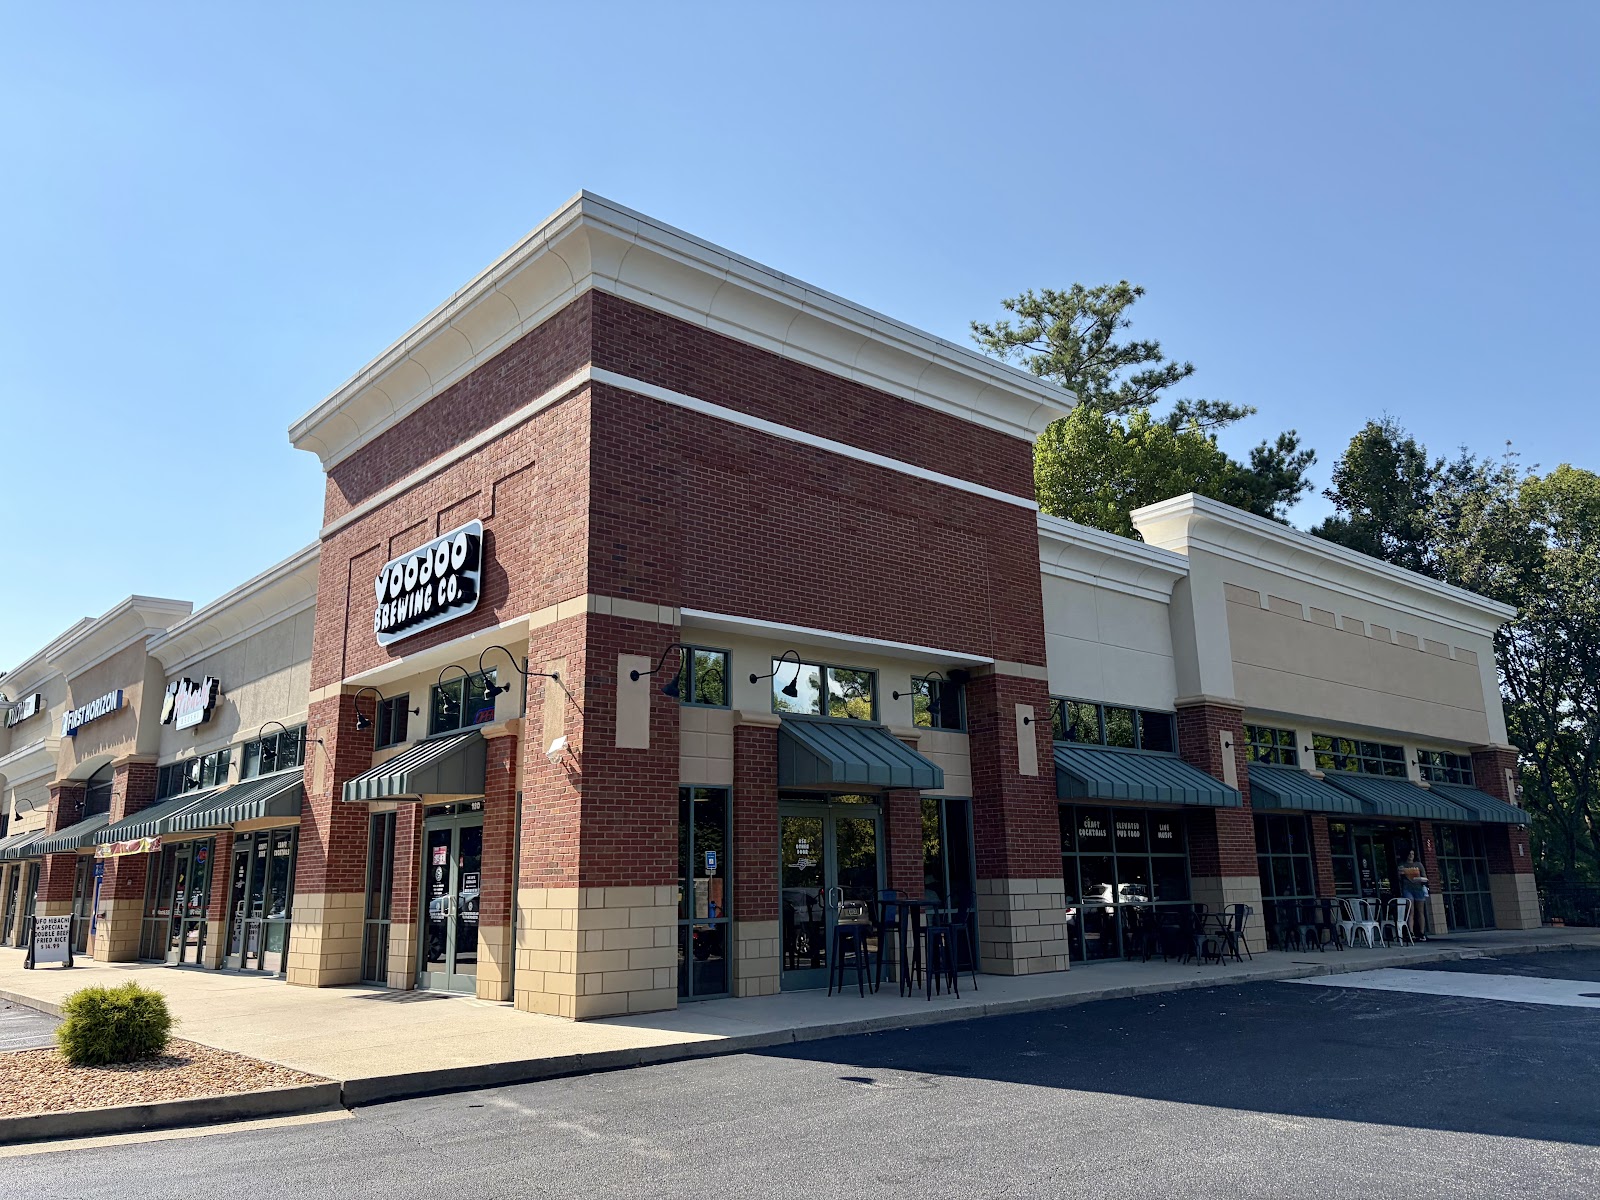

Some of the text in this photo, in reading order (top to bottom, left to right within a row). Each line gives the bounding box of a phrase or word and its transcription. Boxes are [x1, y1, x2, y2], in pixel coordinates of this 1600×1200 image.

[374, 574, 462, 633] BREWING CO.
[67, 690, 118, 731] FIRST HORIZON
[1083, 821, 1100, 829] CRAFT
[1116, 822, 1139, 830] ELEVATED
[1078, 829, 1106, 837] COCKTAILS
[1116, 830, 1127, 838] PUB
[1157, 831, 1172, 839] MUSIC
